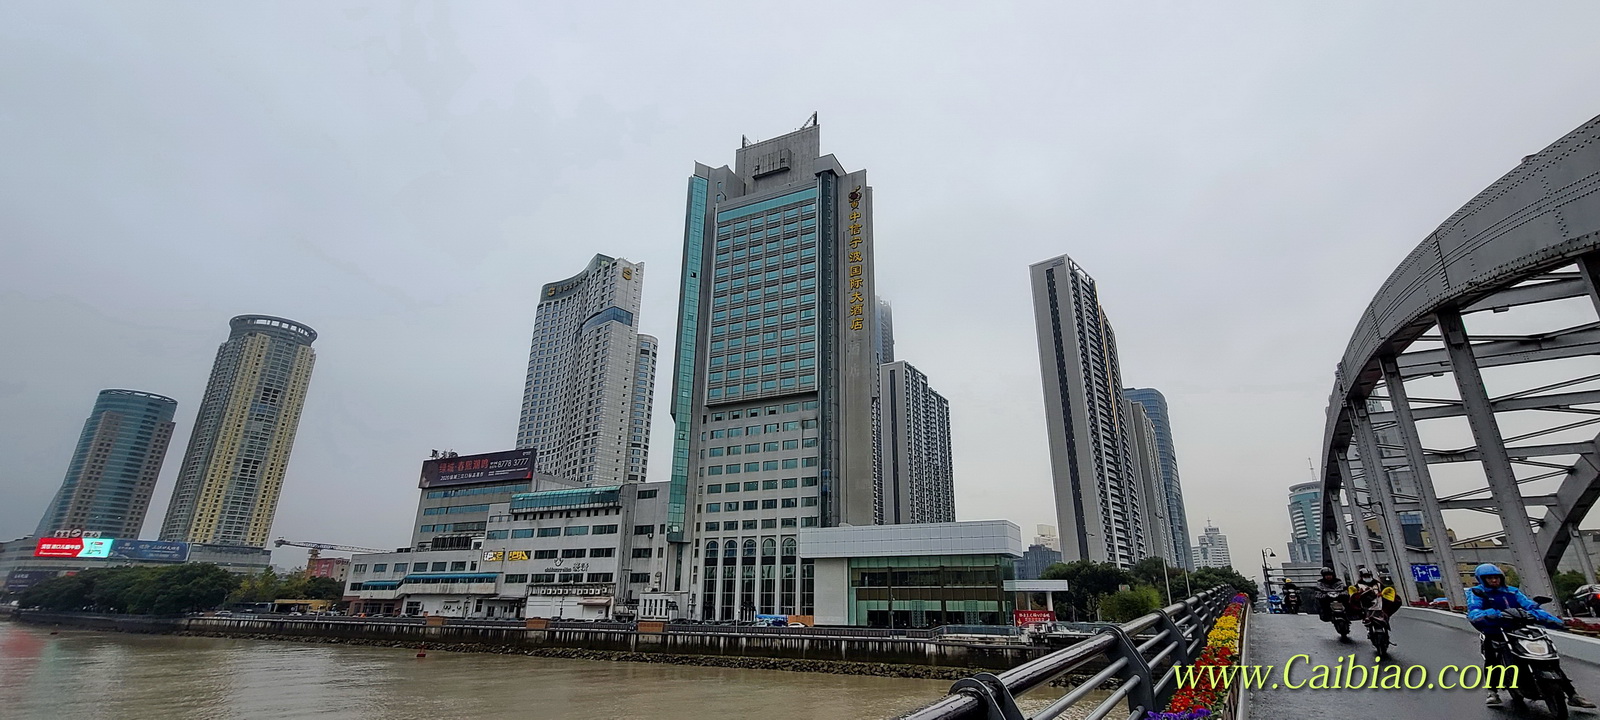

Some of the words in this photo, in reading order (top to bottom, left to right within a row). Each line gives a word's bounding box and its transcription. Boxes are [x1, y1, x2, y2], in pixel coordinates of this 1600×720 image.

[849, 211, 864, 331] 中信宁波国际大酒店
[497, 460, 512, 468] 8778
[513, 457, 529, 467] 3777
